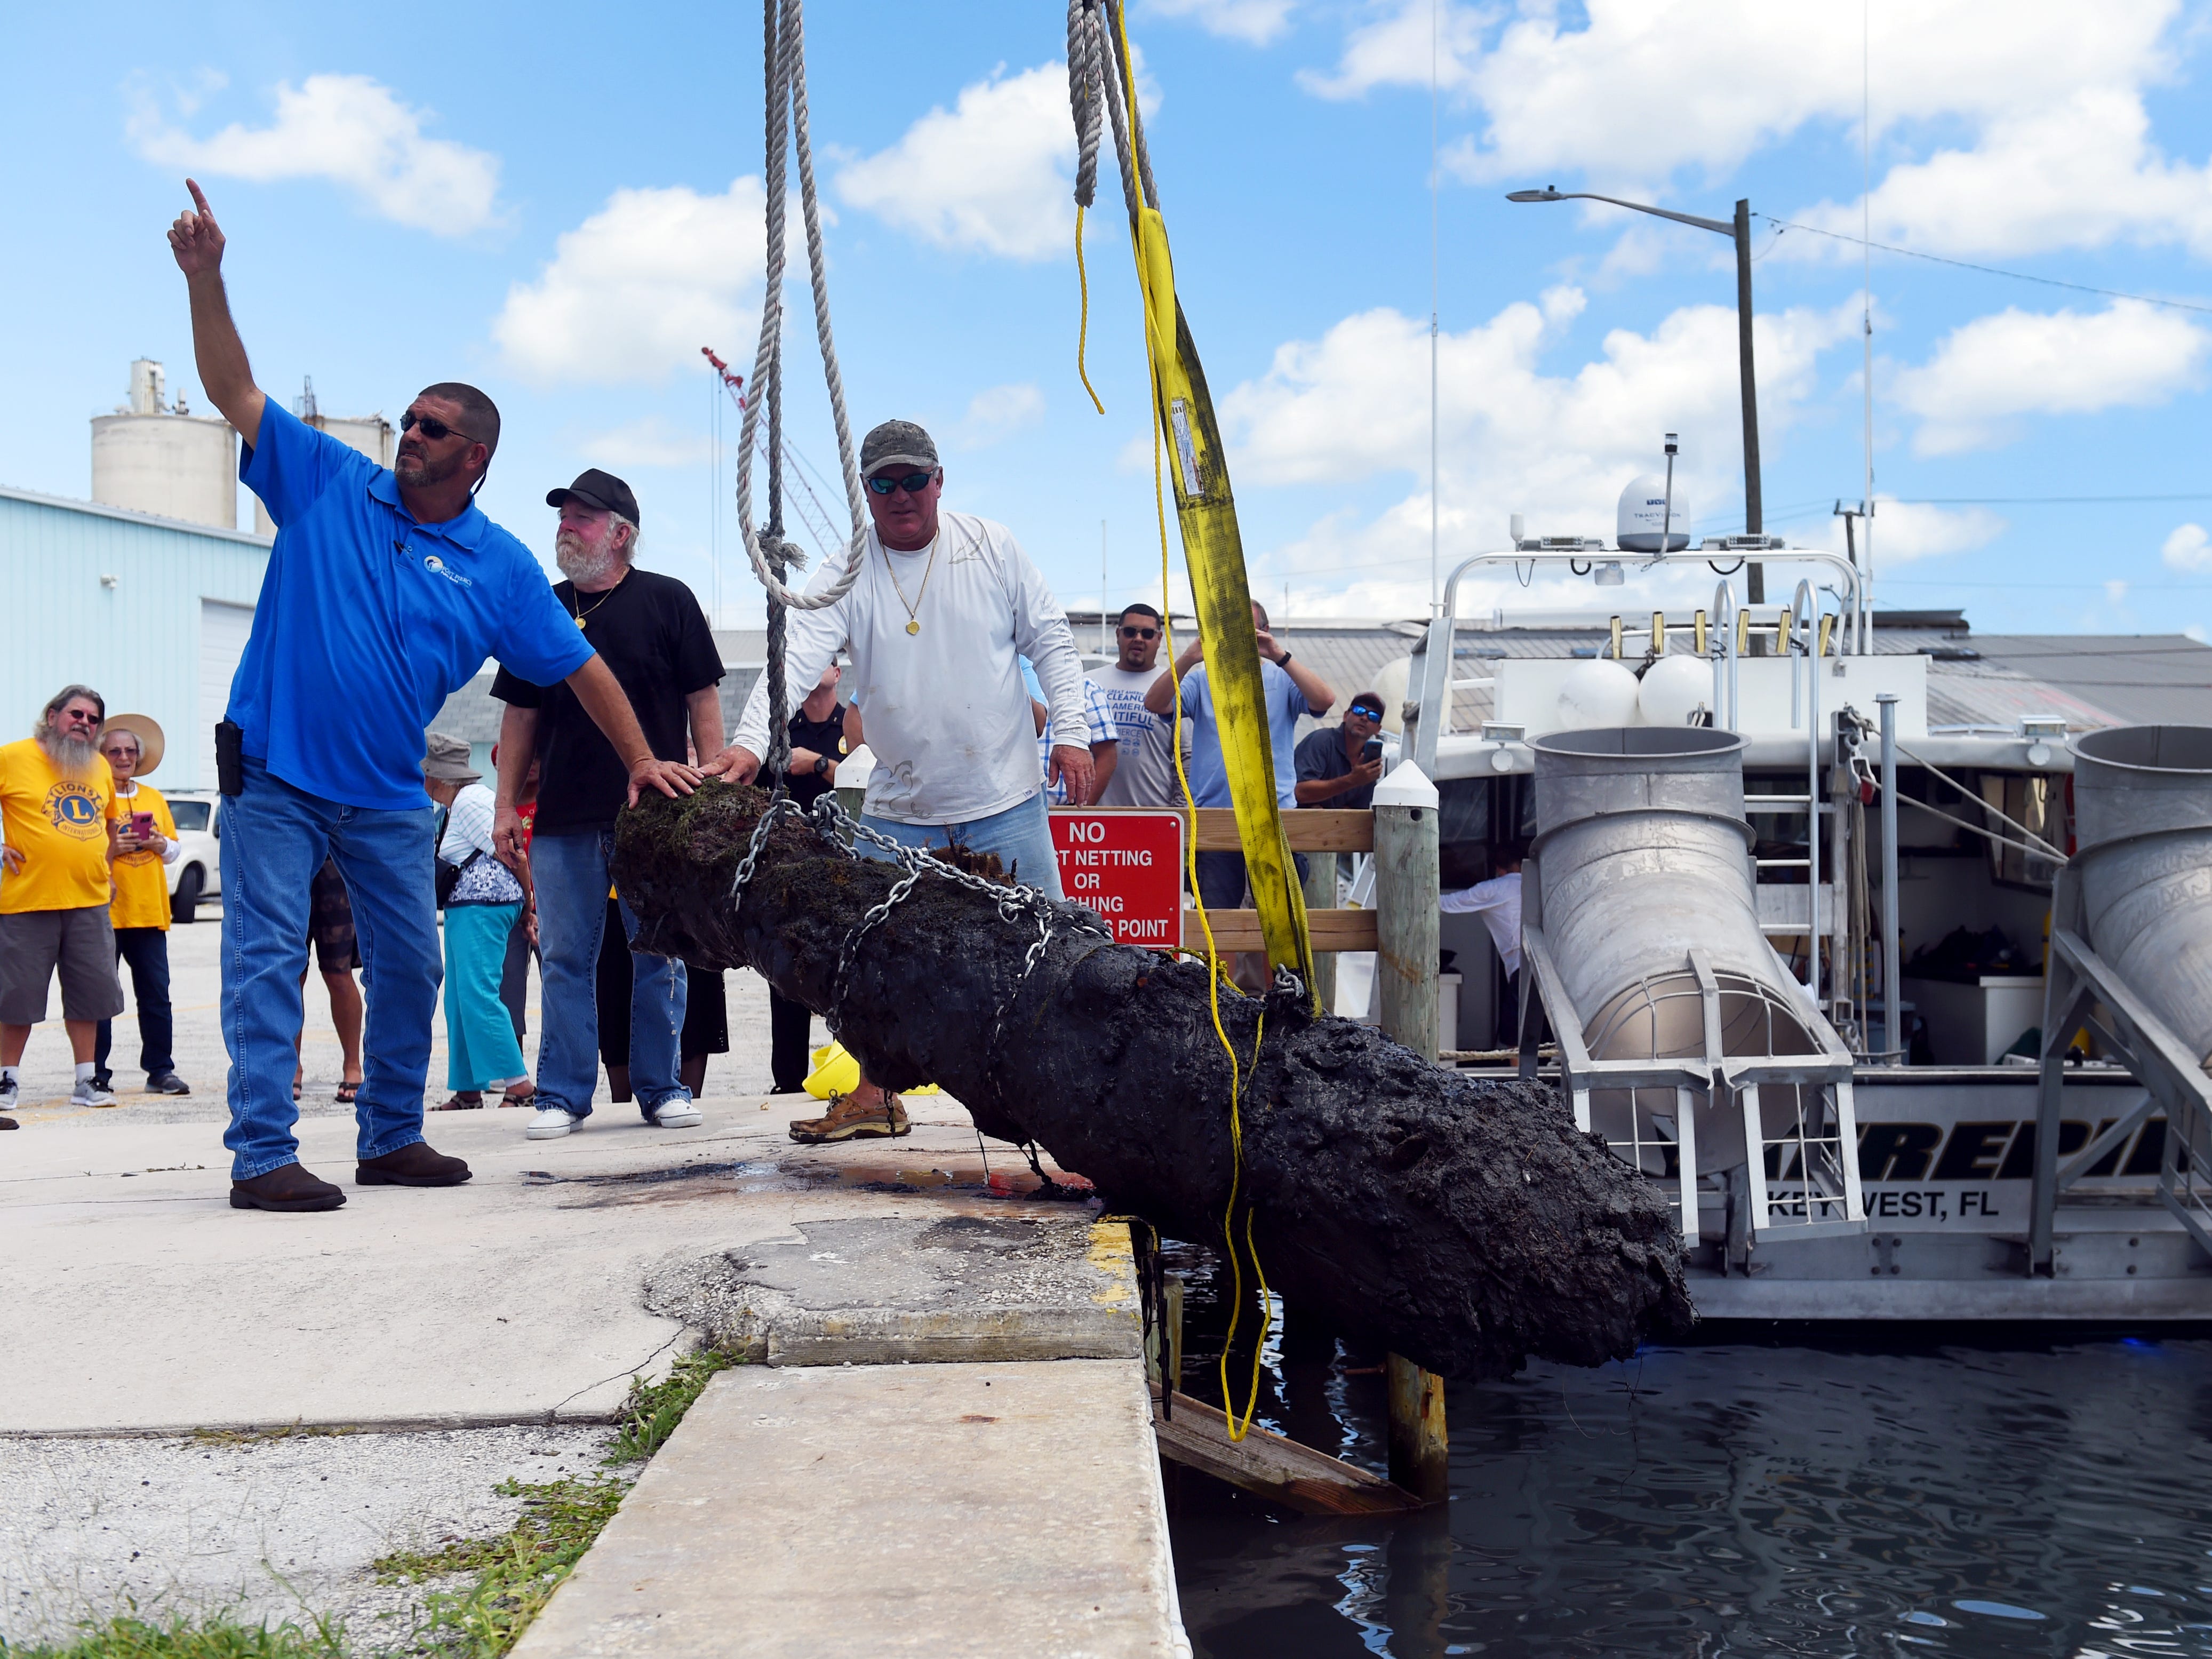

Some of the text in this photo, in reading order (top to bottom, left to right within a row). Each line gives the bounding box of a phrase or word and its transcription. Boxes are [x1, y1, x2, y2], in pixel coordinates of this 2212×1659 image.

[54, 783, 94, 797] LIONS
[69, 799, 90, 819] L
[1069, 821, 1105, 843] NO
[1075, 850, 1152, 866] NETTING
[1074, 873, 1100, 889] OR
[1119, 919, 1168, 937] POINT
[1960, 1191, 1999, 1216] FL
